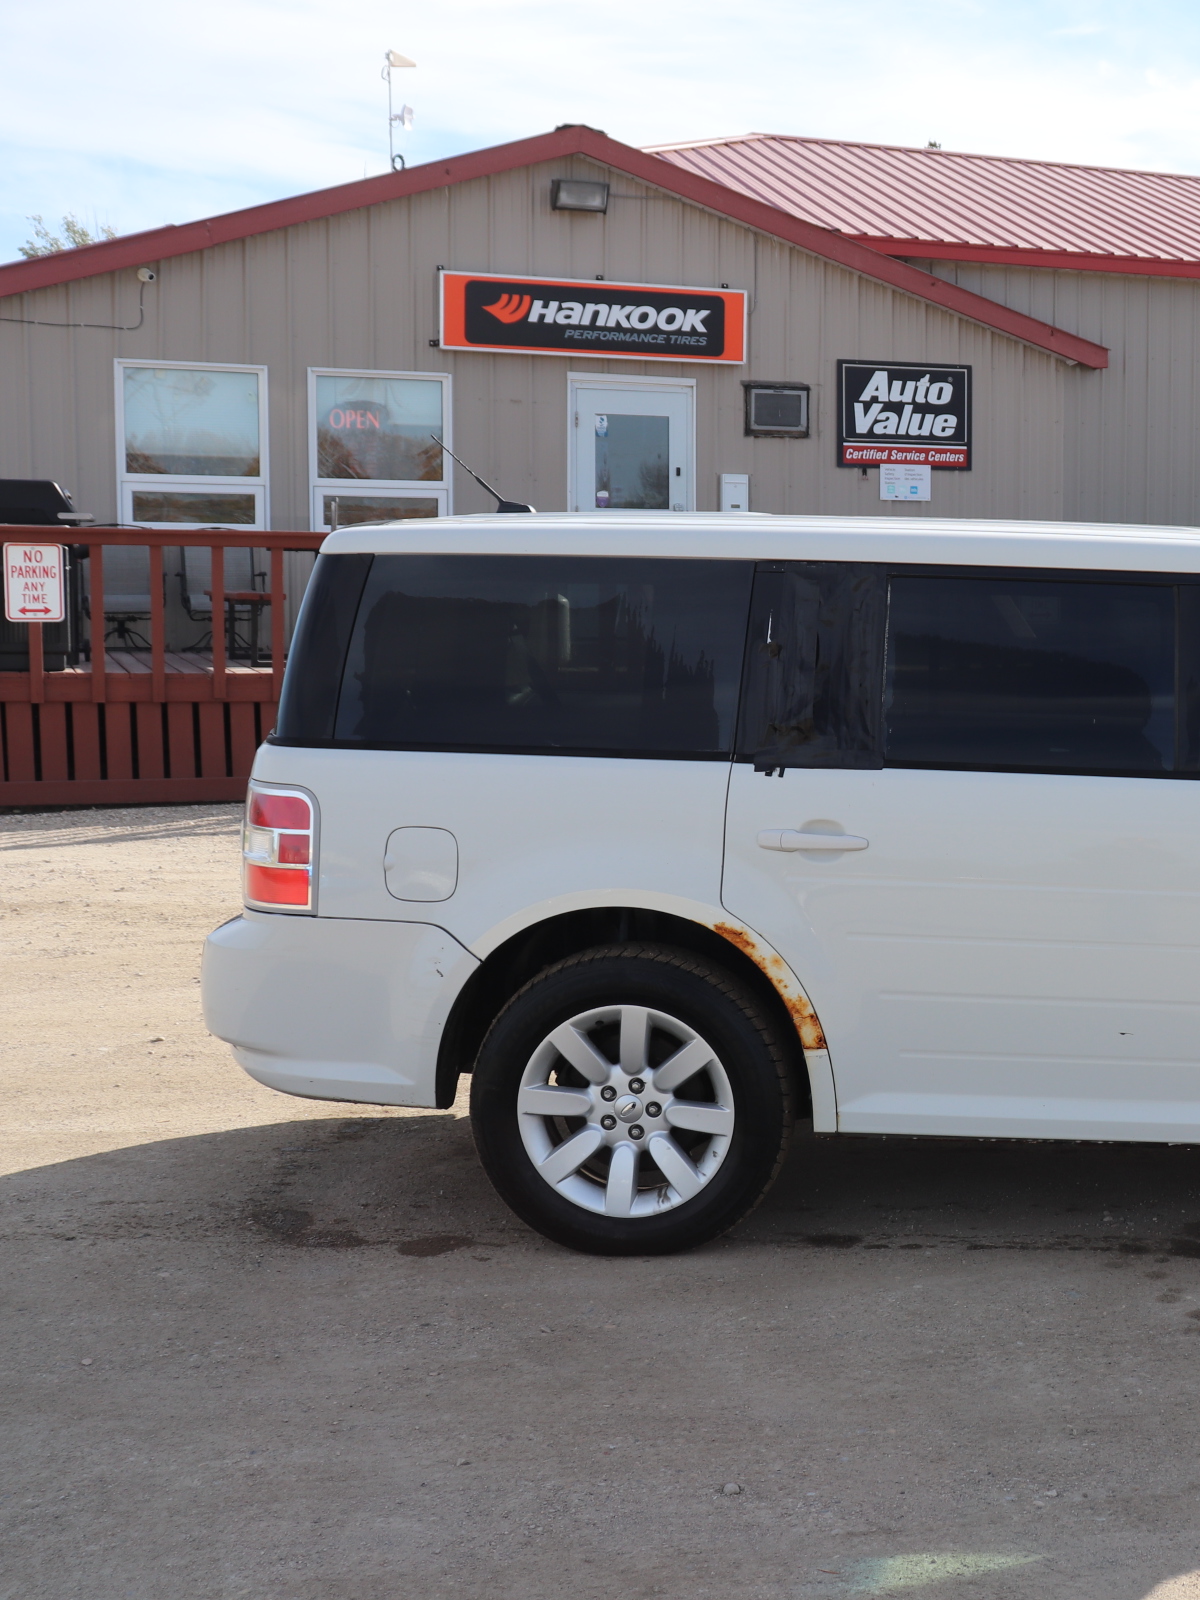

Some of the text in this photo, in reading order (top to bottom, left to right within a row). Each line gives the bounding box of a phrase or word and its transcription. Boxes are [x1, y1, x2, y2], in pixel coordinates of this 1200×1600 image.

[564, 329, 708, 346] PERFORMANCE TIRES
[859, 370, 953, 405] Auto
[329, 408, 380, 429] OPEN
[853, 402, 958, 437] Value
[845, 448, 965, 462] Certified Service Centers
[23, 550, 43, 563] NO
[10, 565, 57, 579] PARKING
[23, 581, 45, 592] ANY
[21, 593, 48, 604] TIME
